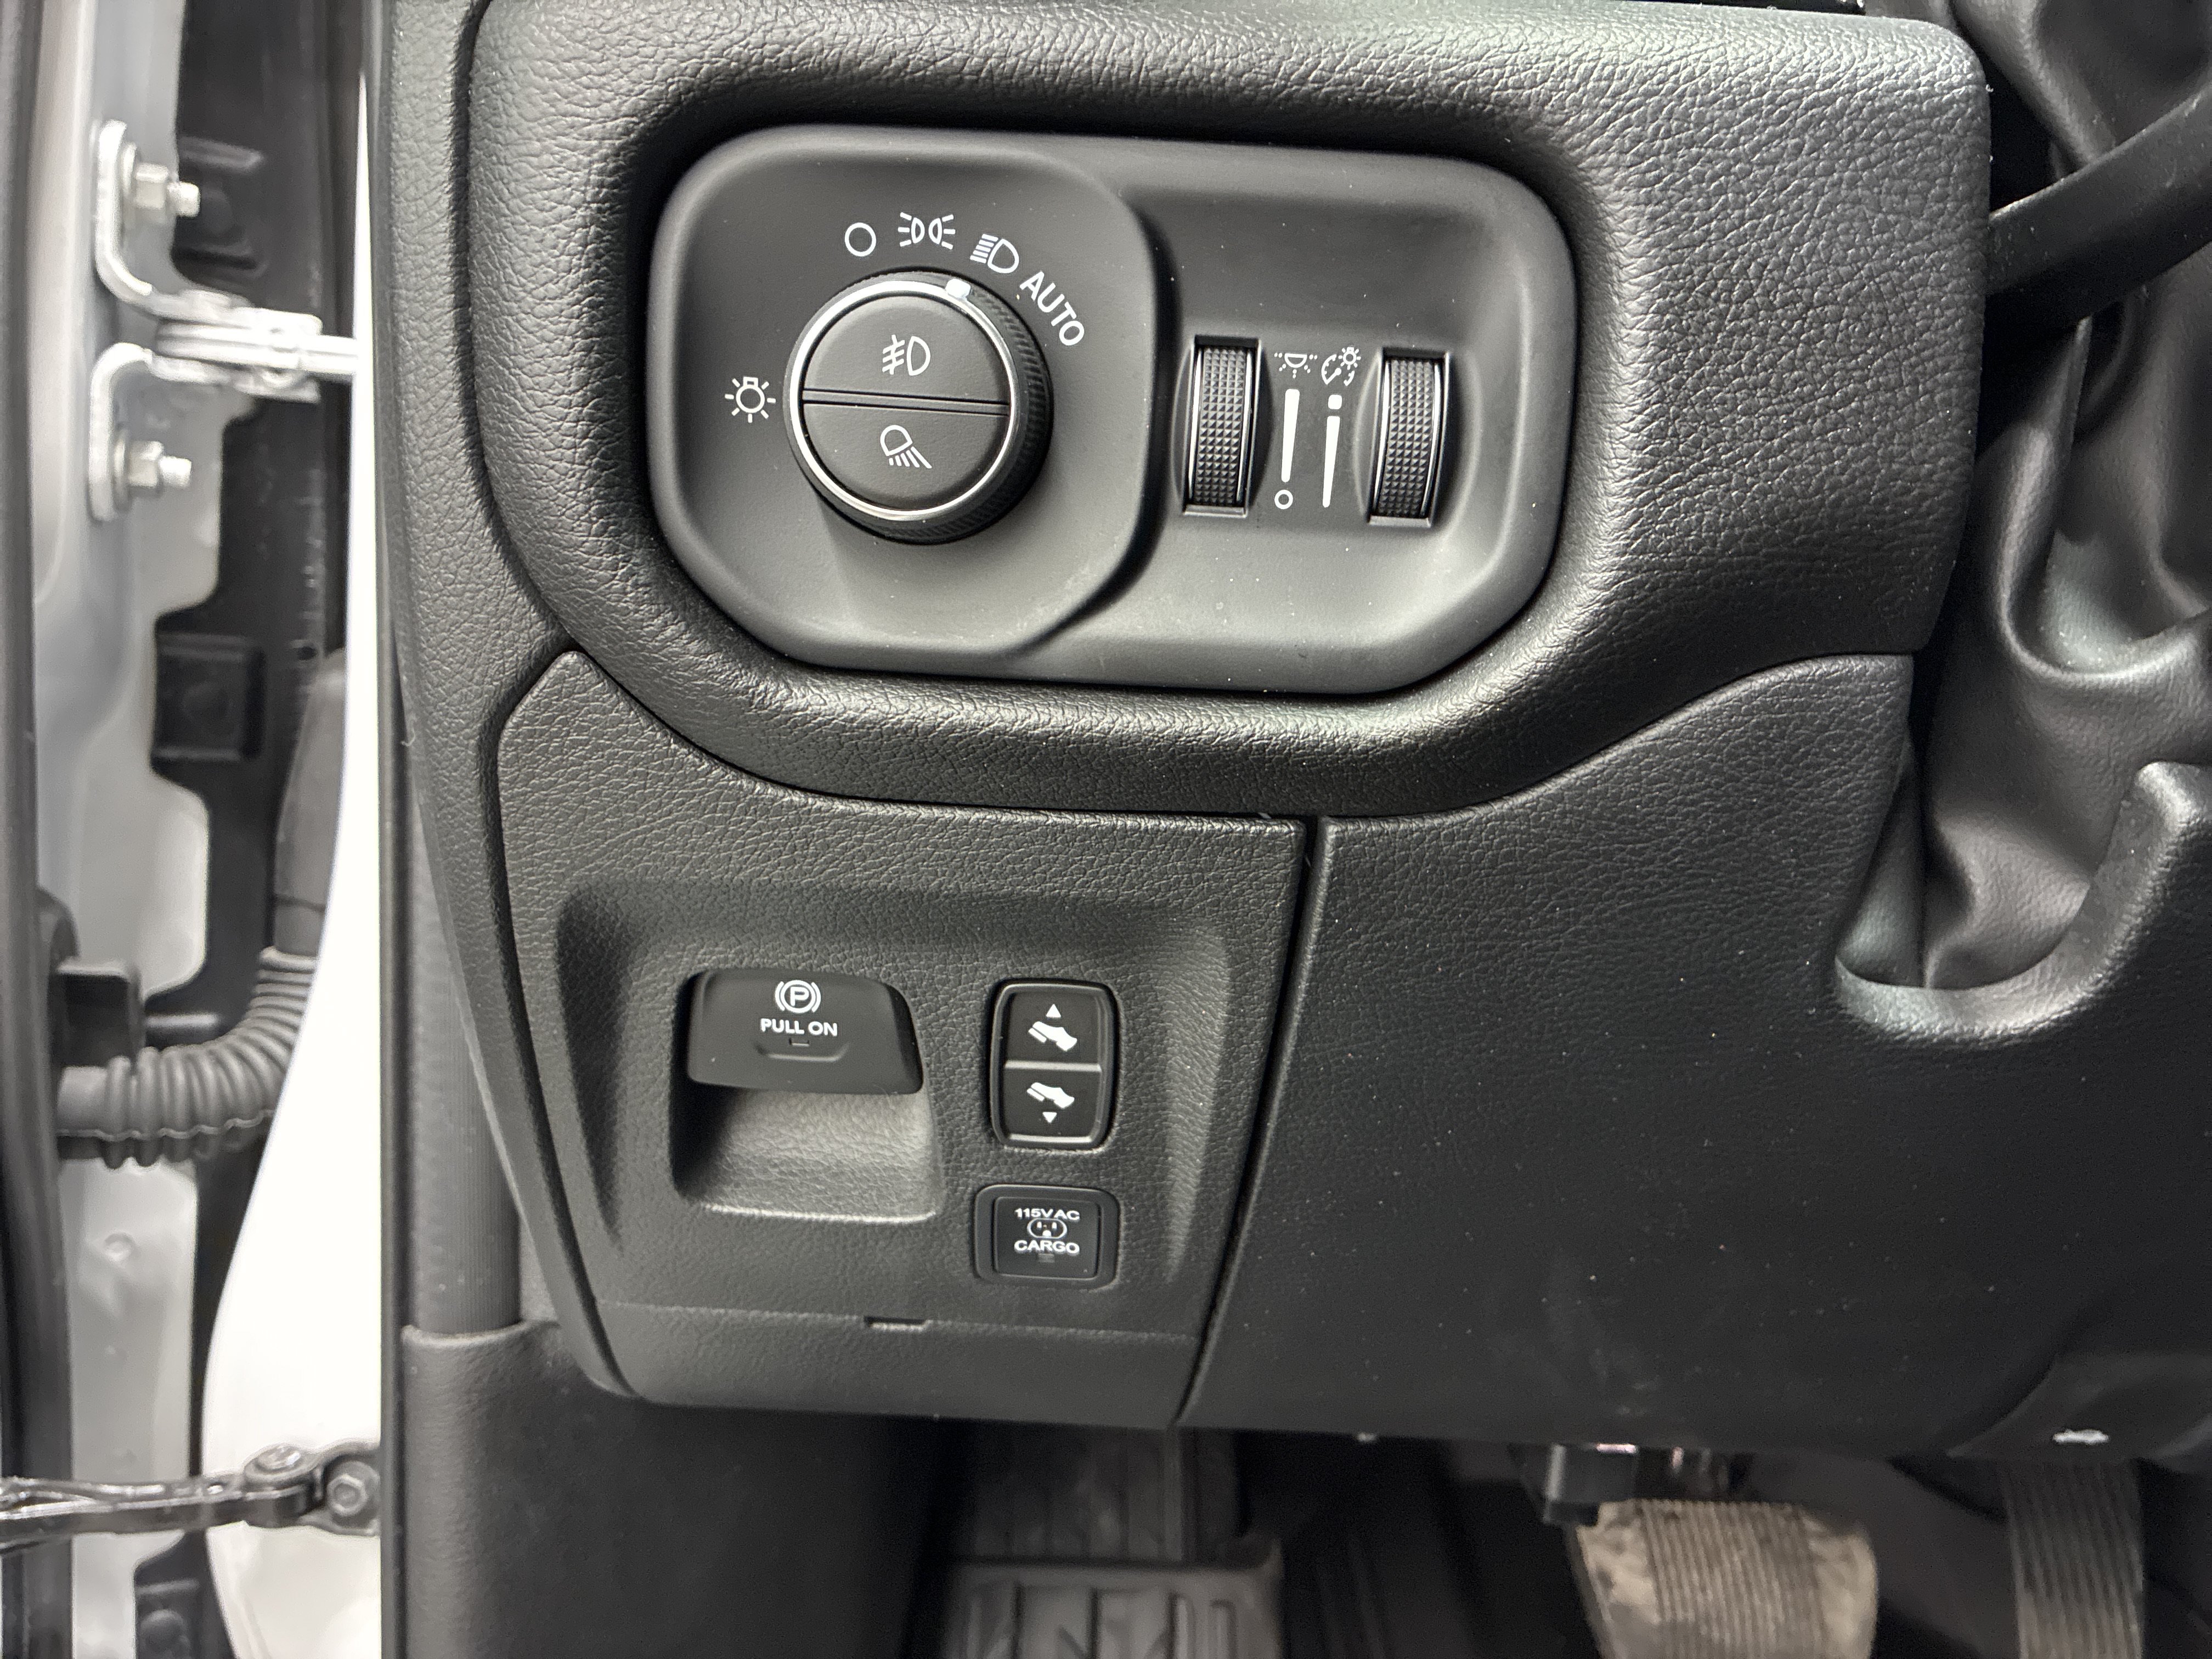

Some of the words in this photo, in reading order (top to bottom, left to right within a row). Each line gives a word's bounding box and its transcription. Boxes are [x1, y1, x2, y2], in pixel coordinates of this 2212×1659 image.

[1019, 271, 1085, 346] AUTO
[760, 1018, 805, 1035] PULL
[808, 1021, 838, 1036] ON
[1014, 1240, 1080, 1255] CARGO
